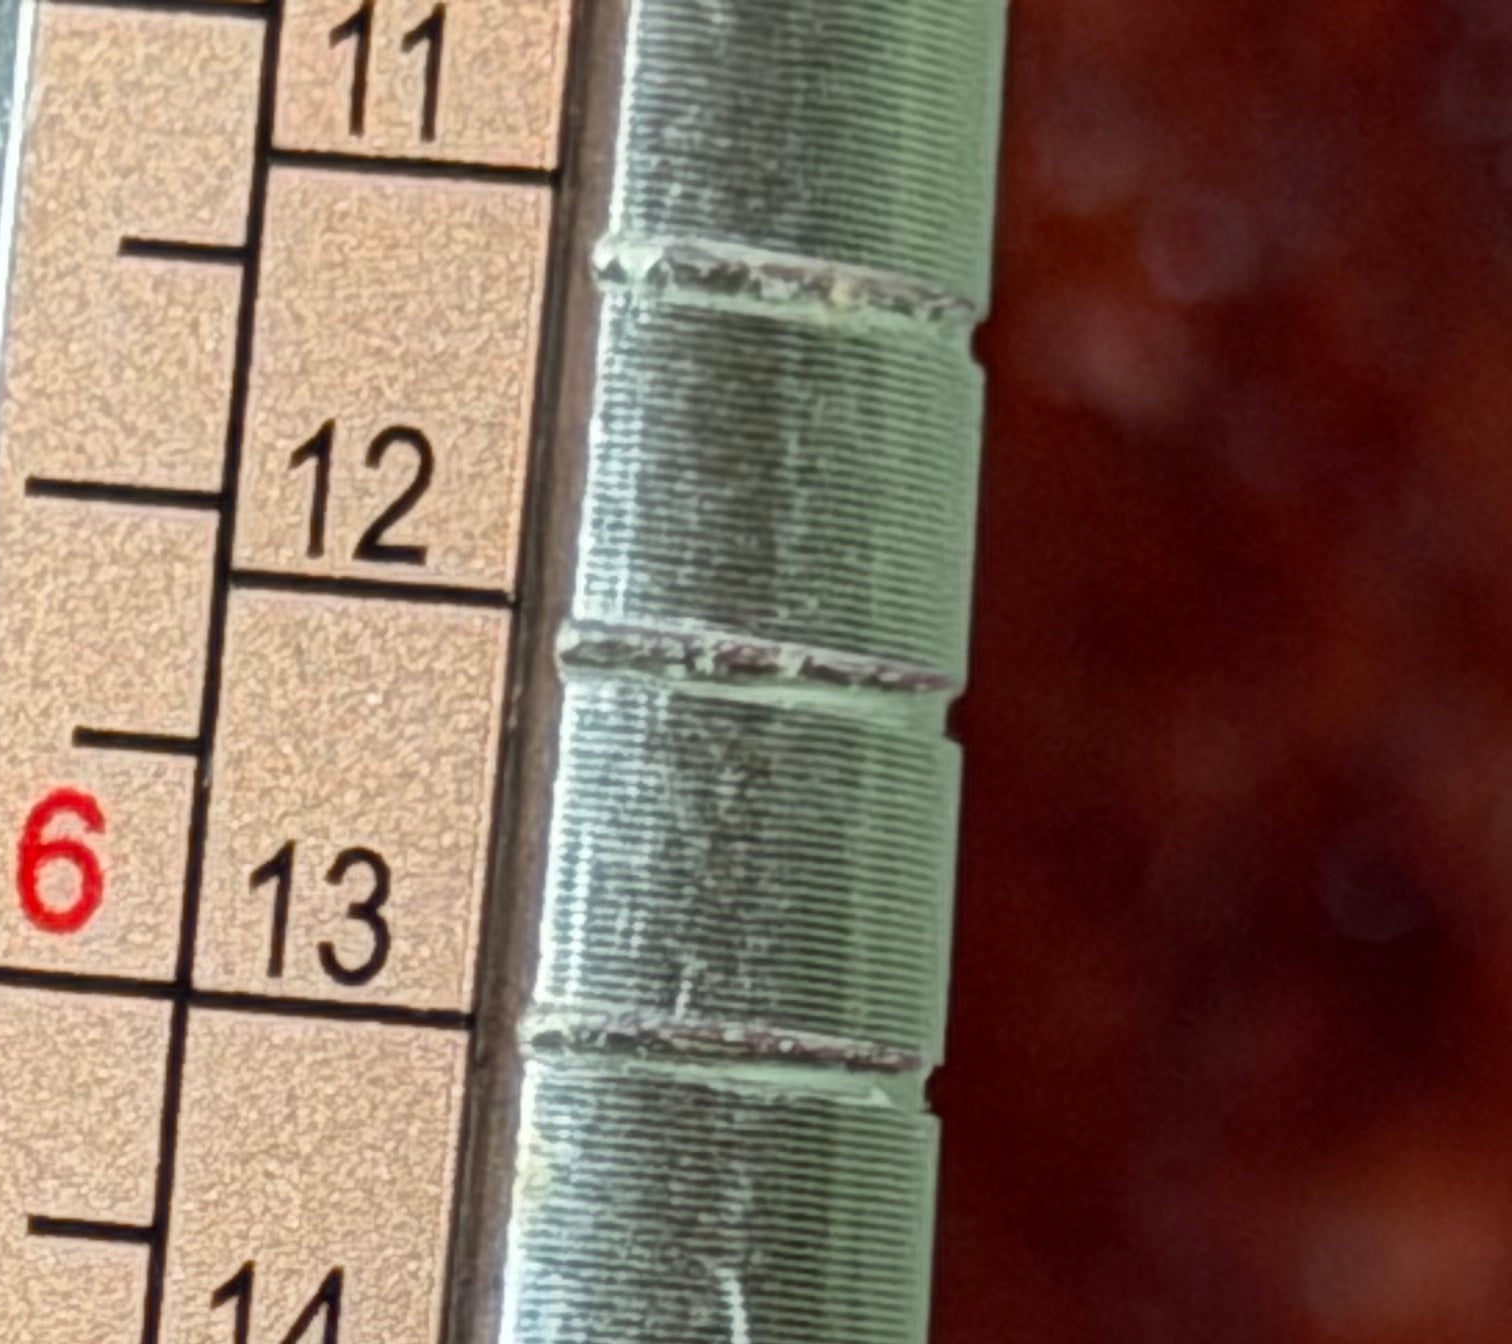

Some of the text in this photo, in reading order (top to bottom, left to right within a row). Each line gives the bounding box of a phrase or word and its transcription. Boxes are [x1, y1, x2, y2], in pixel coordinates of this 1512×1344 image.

[332, 0, 445, 140] 11
[291, 421, 434, 566] 12
[16, 786, 106, 935] 6
[251, 842, 391, 987] 13
